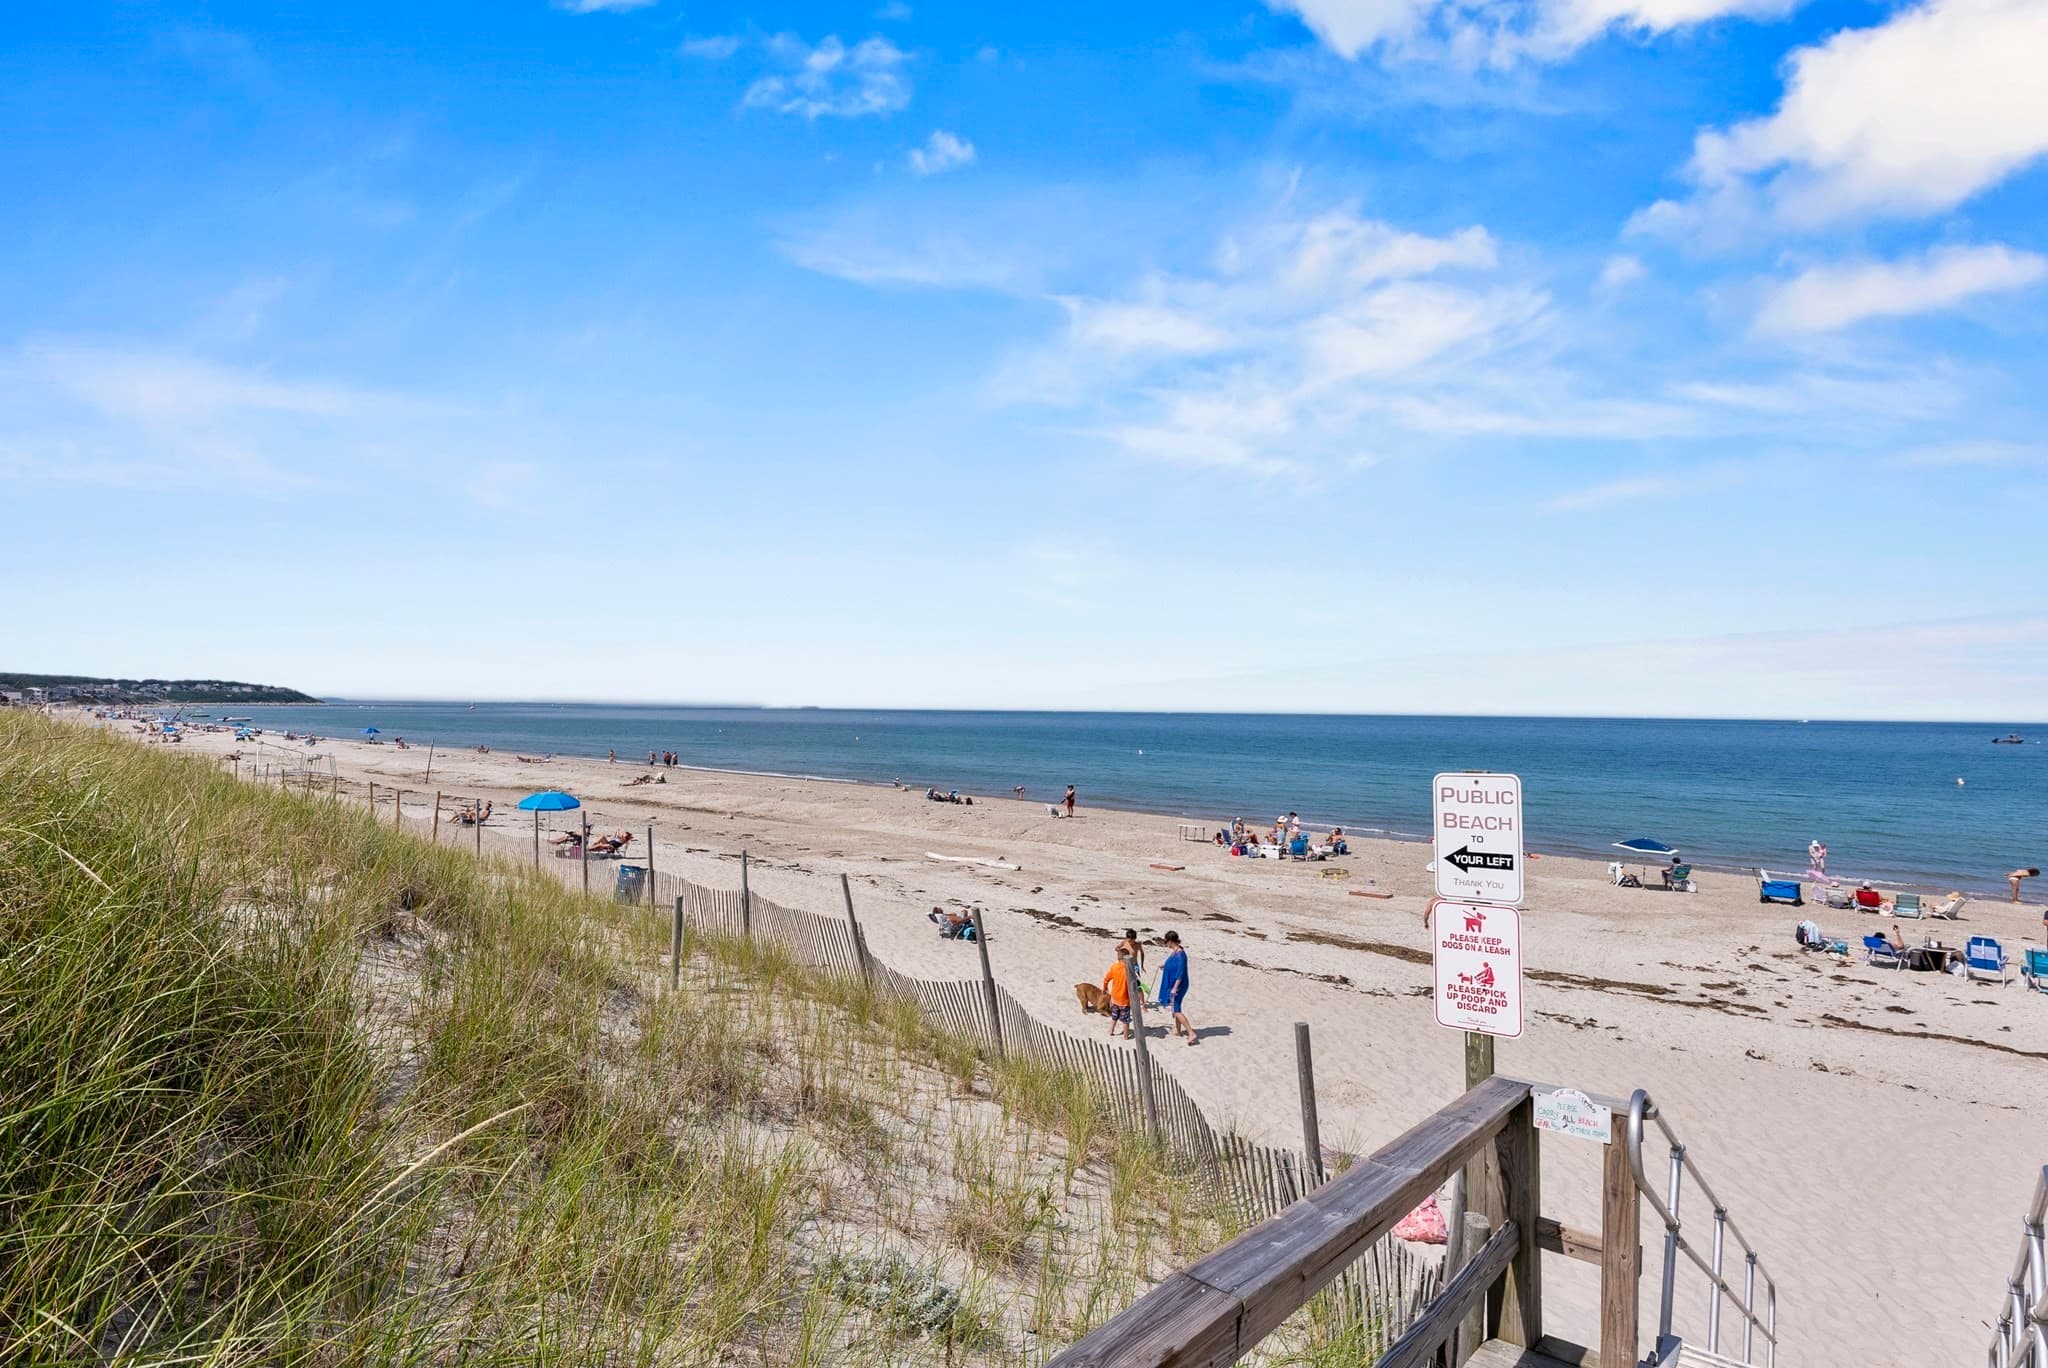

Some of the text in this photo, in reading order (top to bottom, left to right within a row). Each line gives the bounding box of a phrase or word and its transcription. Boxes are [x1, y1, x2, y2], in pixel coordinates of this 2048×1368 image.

[1441, 787, 1514, 804] PUBLIC
[1443, 813, 1512, 831] BEACH
[1471, 835, 1484, 843] TO
[1453, 854, 1512, 867] YOUR LEFT
[1454, 878, 1504, 889] THANK YOU
[1449, 933, 1502, 946] PLEASE KEEP
[1442, 941, 1463, 950] DOGS
[1465, 943, 1476, 952] ON
[1485, 946, 1511, 956] LEASH
[1447, 984, 1506, 999] PLEASE PICK
[1446, 992, 1508, 1008] UP POOP AND
[1457, 1002, 1497, 1014] DISCARD
[1562, 1115, 1575, 1124] ALL
